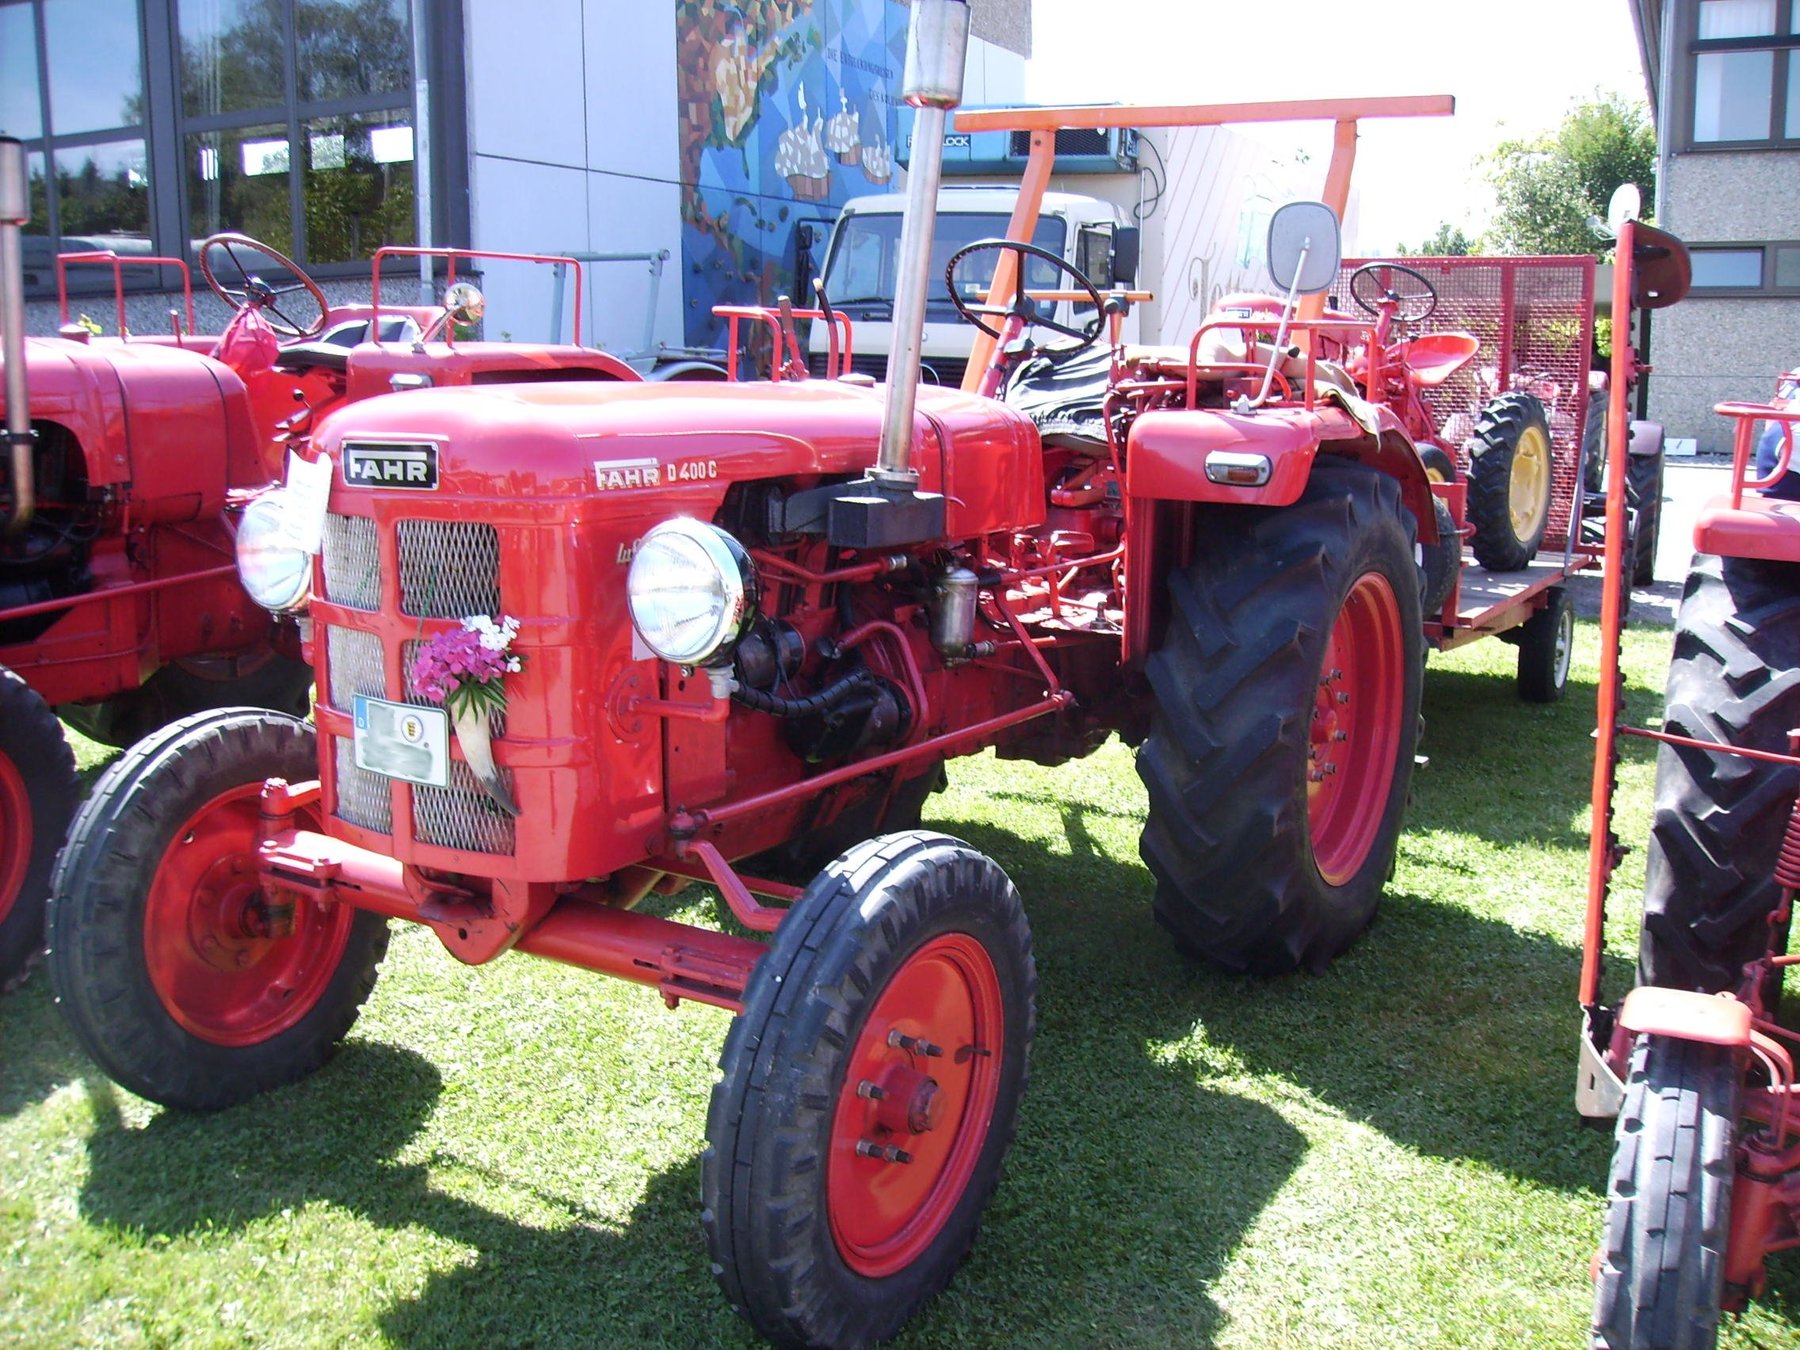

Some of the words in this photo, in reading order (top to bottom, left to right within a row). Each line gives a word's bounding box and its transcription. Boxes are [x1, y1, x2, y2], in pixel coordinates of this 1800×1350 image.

[349, 449, 428, 482] FAHR
[593, 458, 661, 490] FAHR
[667, 463, 677, 482] D
